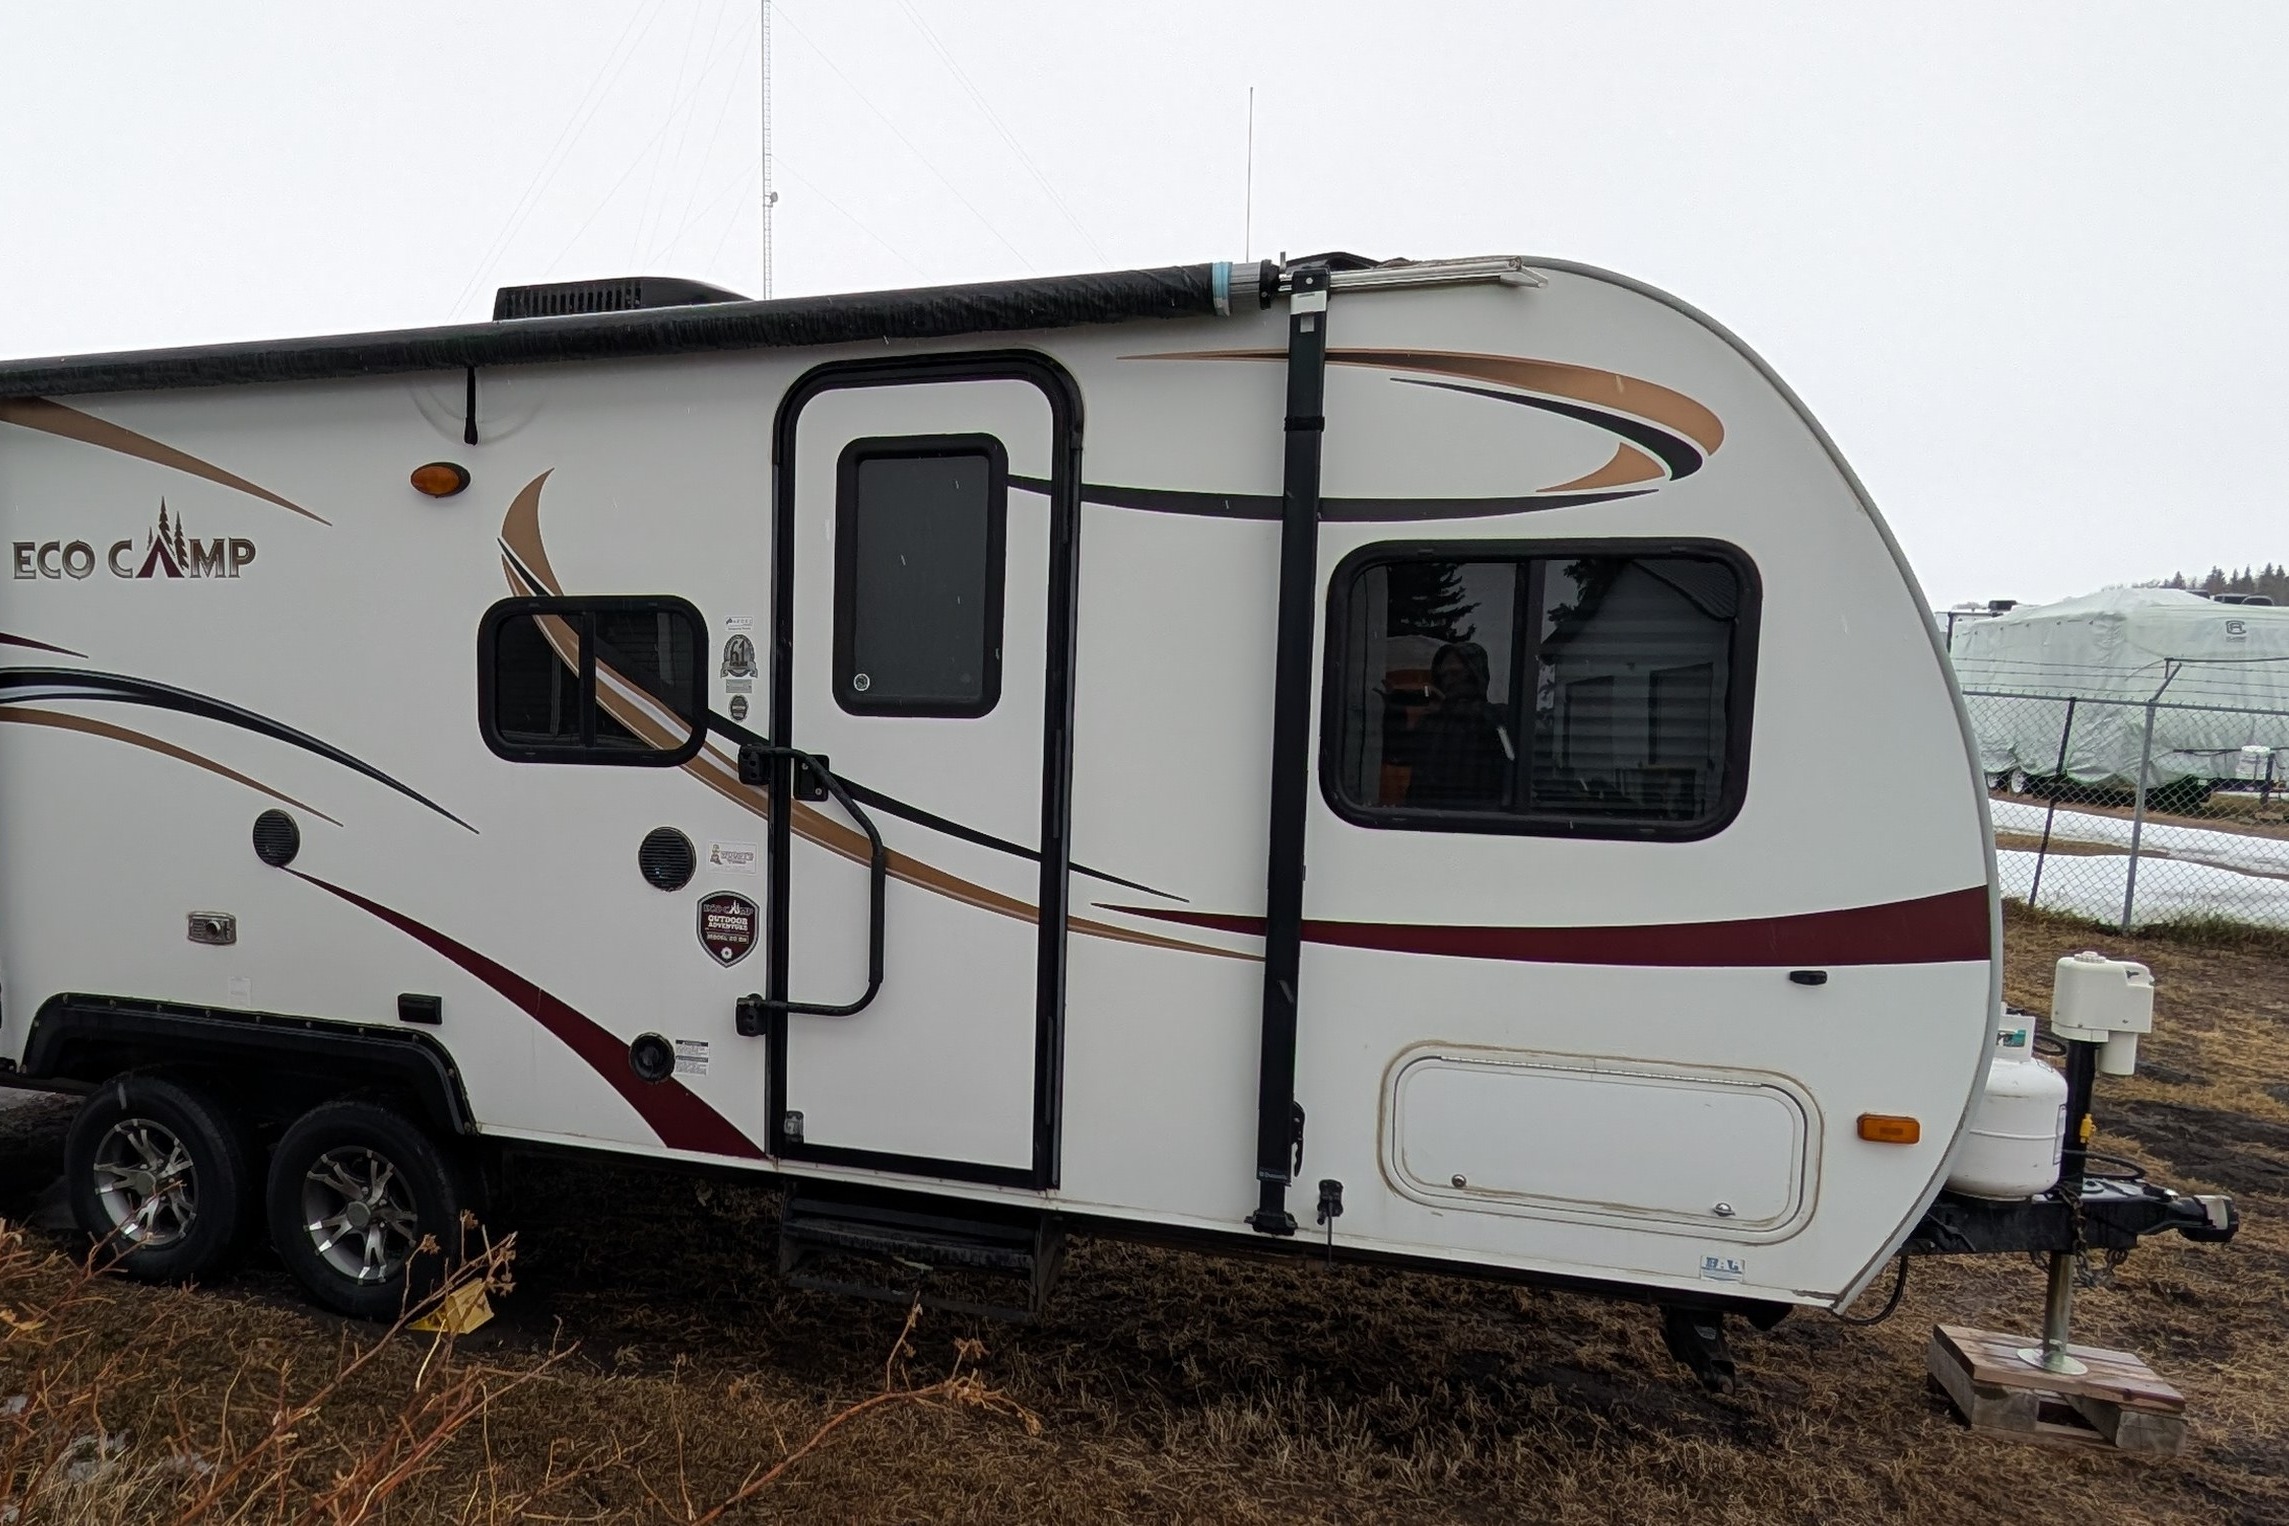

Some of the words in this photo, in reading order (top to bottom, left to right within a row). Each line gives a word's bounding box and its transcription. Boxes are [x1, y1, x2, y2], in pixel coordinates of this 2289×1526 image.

[12, 539, 96, 581] ECO
[107, 526, 257, 580] CAMP
[707, 915, 748, 926] OUTDOOR
[708, 922, 748, 931] ADVENTURE
